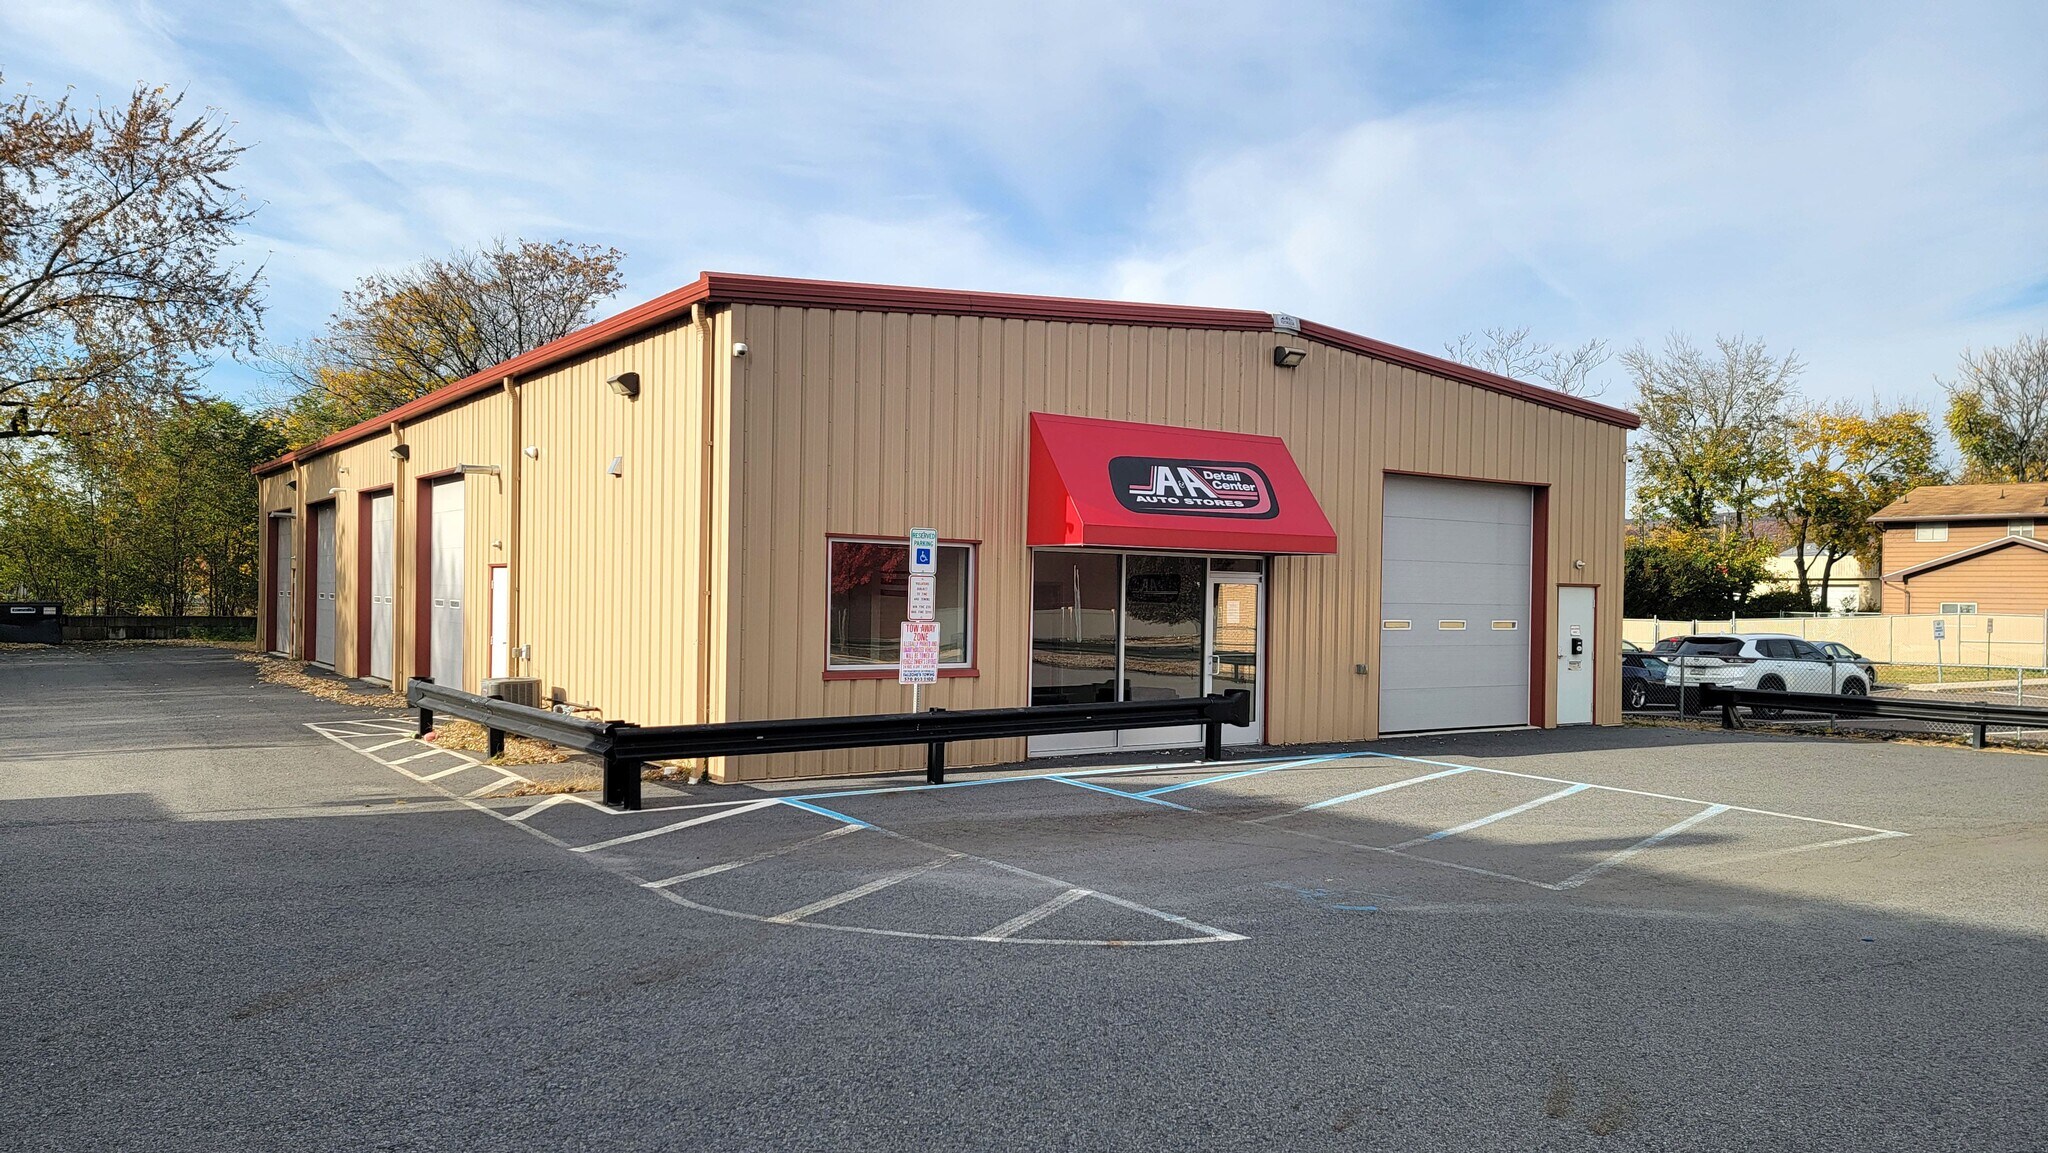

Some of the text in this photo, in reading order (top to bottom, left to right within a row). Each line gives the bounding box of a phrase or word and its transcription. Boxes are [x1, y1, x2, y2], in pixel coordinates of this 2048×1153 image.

[1203, 471, 1241, 482] Detail
[1212, 481, 1256, 492] Center
[1136, 495, 1245, 508] AUTO STORES
[912, 532, 935, 540] RESERVED
[914, 633, 928, 641] ZONE
